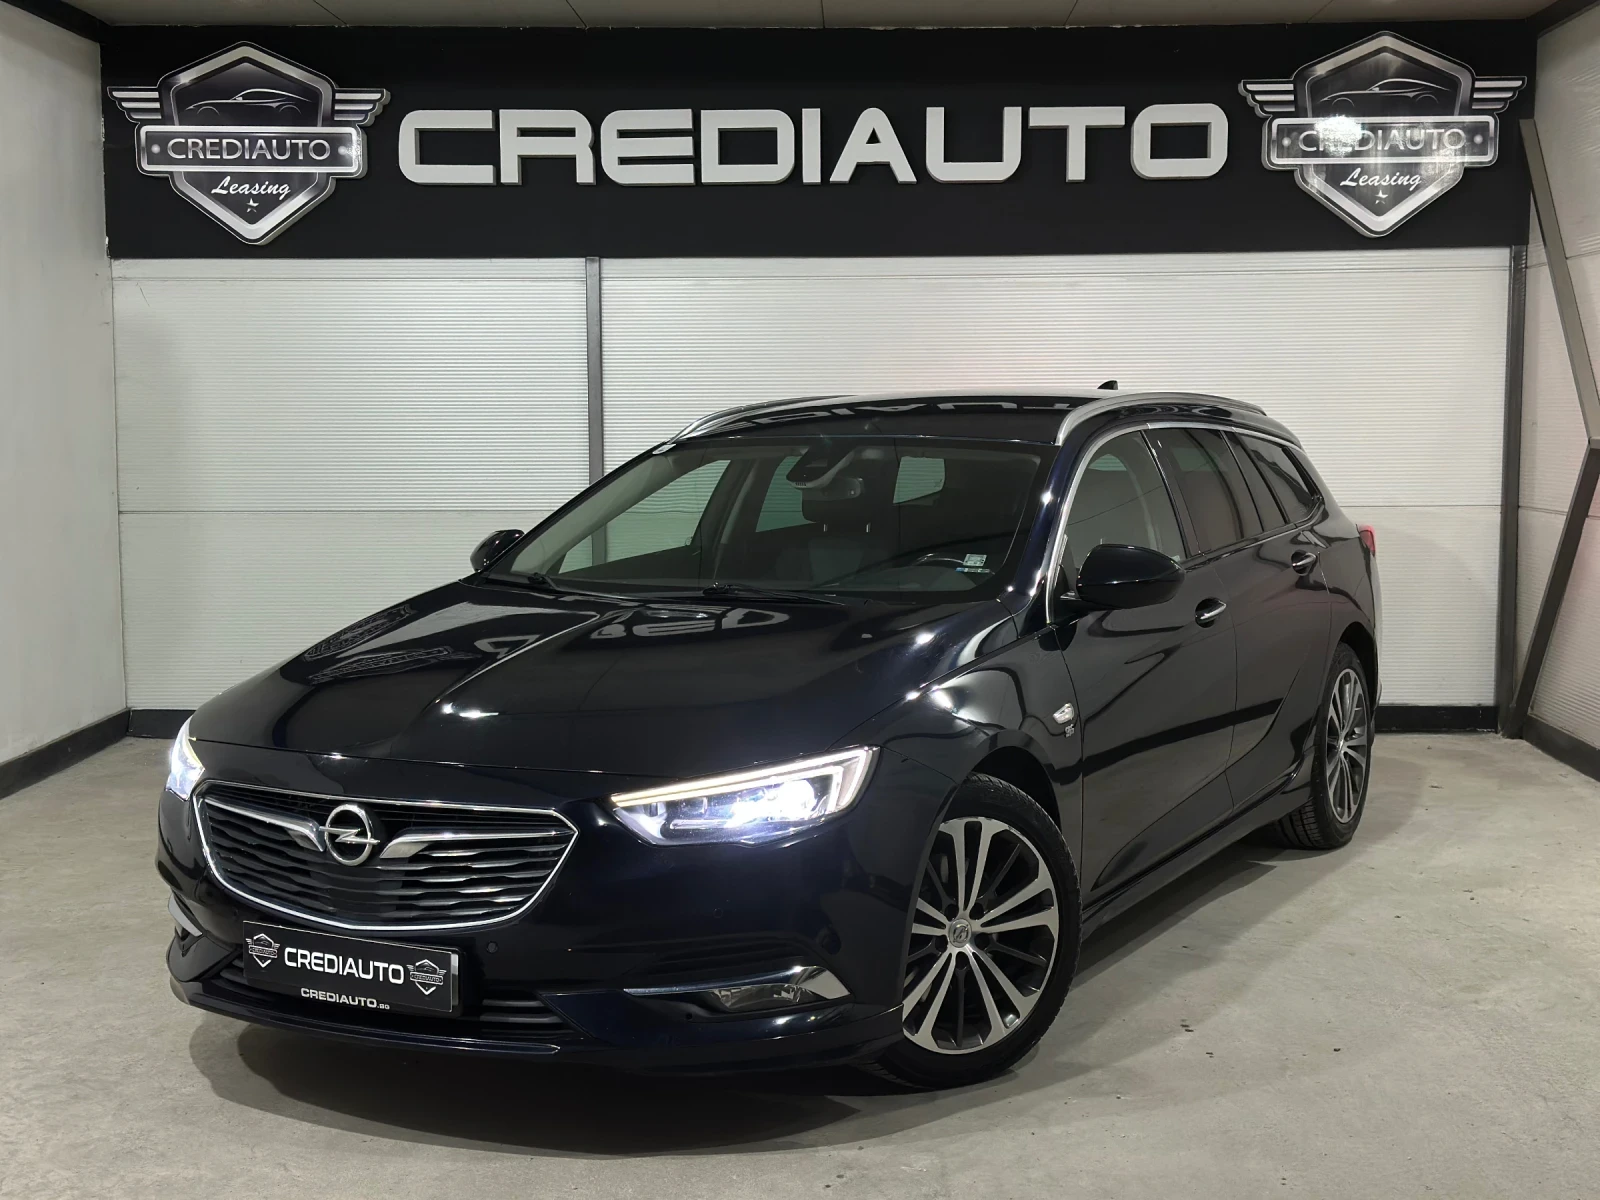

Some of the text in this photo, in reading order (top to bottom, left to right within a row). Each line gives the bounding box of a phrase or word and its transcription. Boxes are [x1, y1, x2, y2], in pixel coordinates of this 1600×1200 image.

[166, 138, 331, 160] CREDIAUTO
[398, 103, 1229, 186] CREDIAUTO
[1298, 127, 1467, 151] CDIAUTO
[211, 175, 292, 200] Leasing
[1339, 166, 1422, 191] Leasing
[284, 947, 405, 985] CREDIAUTO
